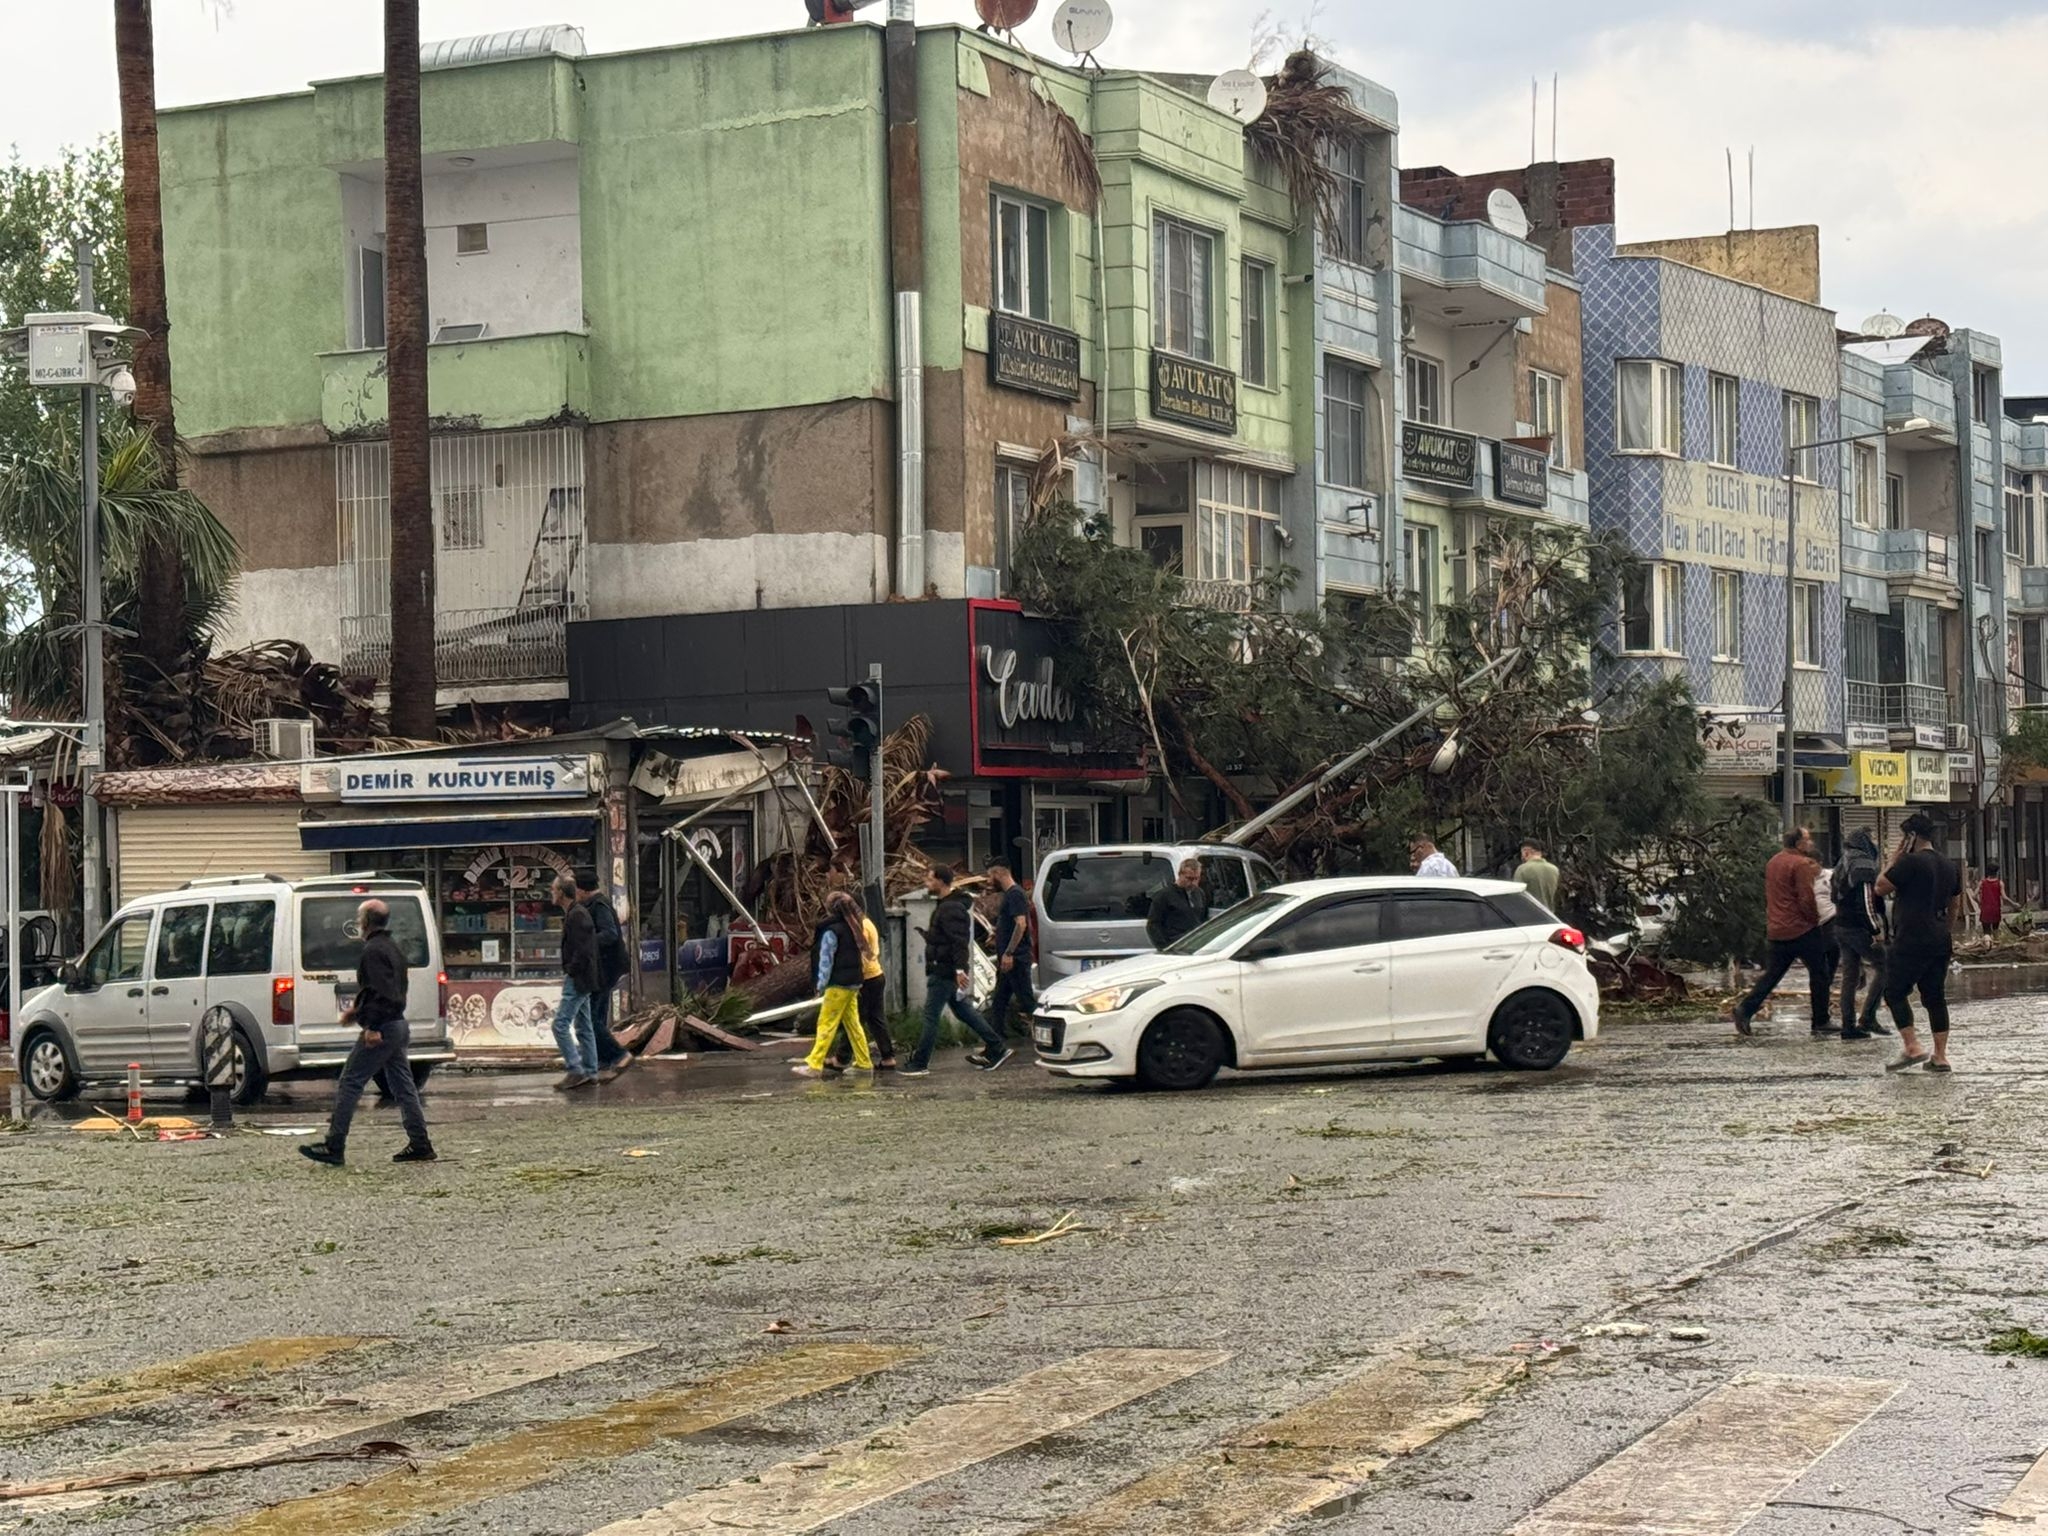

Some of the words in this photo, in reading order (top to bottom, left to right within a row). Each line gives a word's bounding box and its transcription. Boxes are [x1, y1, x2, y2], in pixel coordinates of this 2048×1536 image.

[1013, 327, 1065, 360] AVUKAT
[1171, 362, 1222, 401] AVUKAT
[1417, 433, 1457, 461] AVUKAT
[1665, 513, 1689, 550] New
[1696, 519, 1746, 559] Holland
[1805, 539, 1836, 574] Bayii
[346, 770, 414, 790] DEMİR
[428, 766, 555, 789] KURUYEMİŞ
[510, 865, 529, 889] 2
